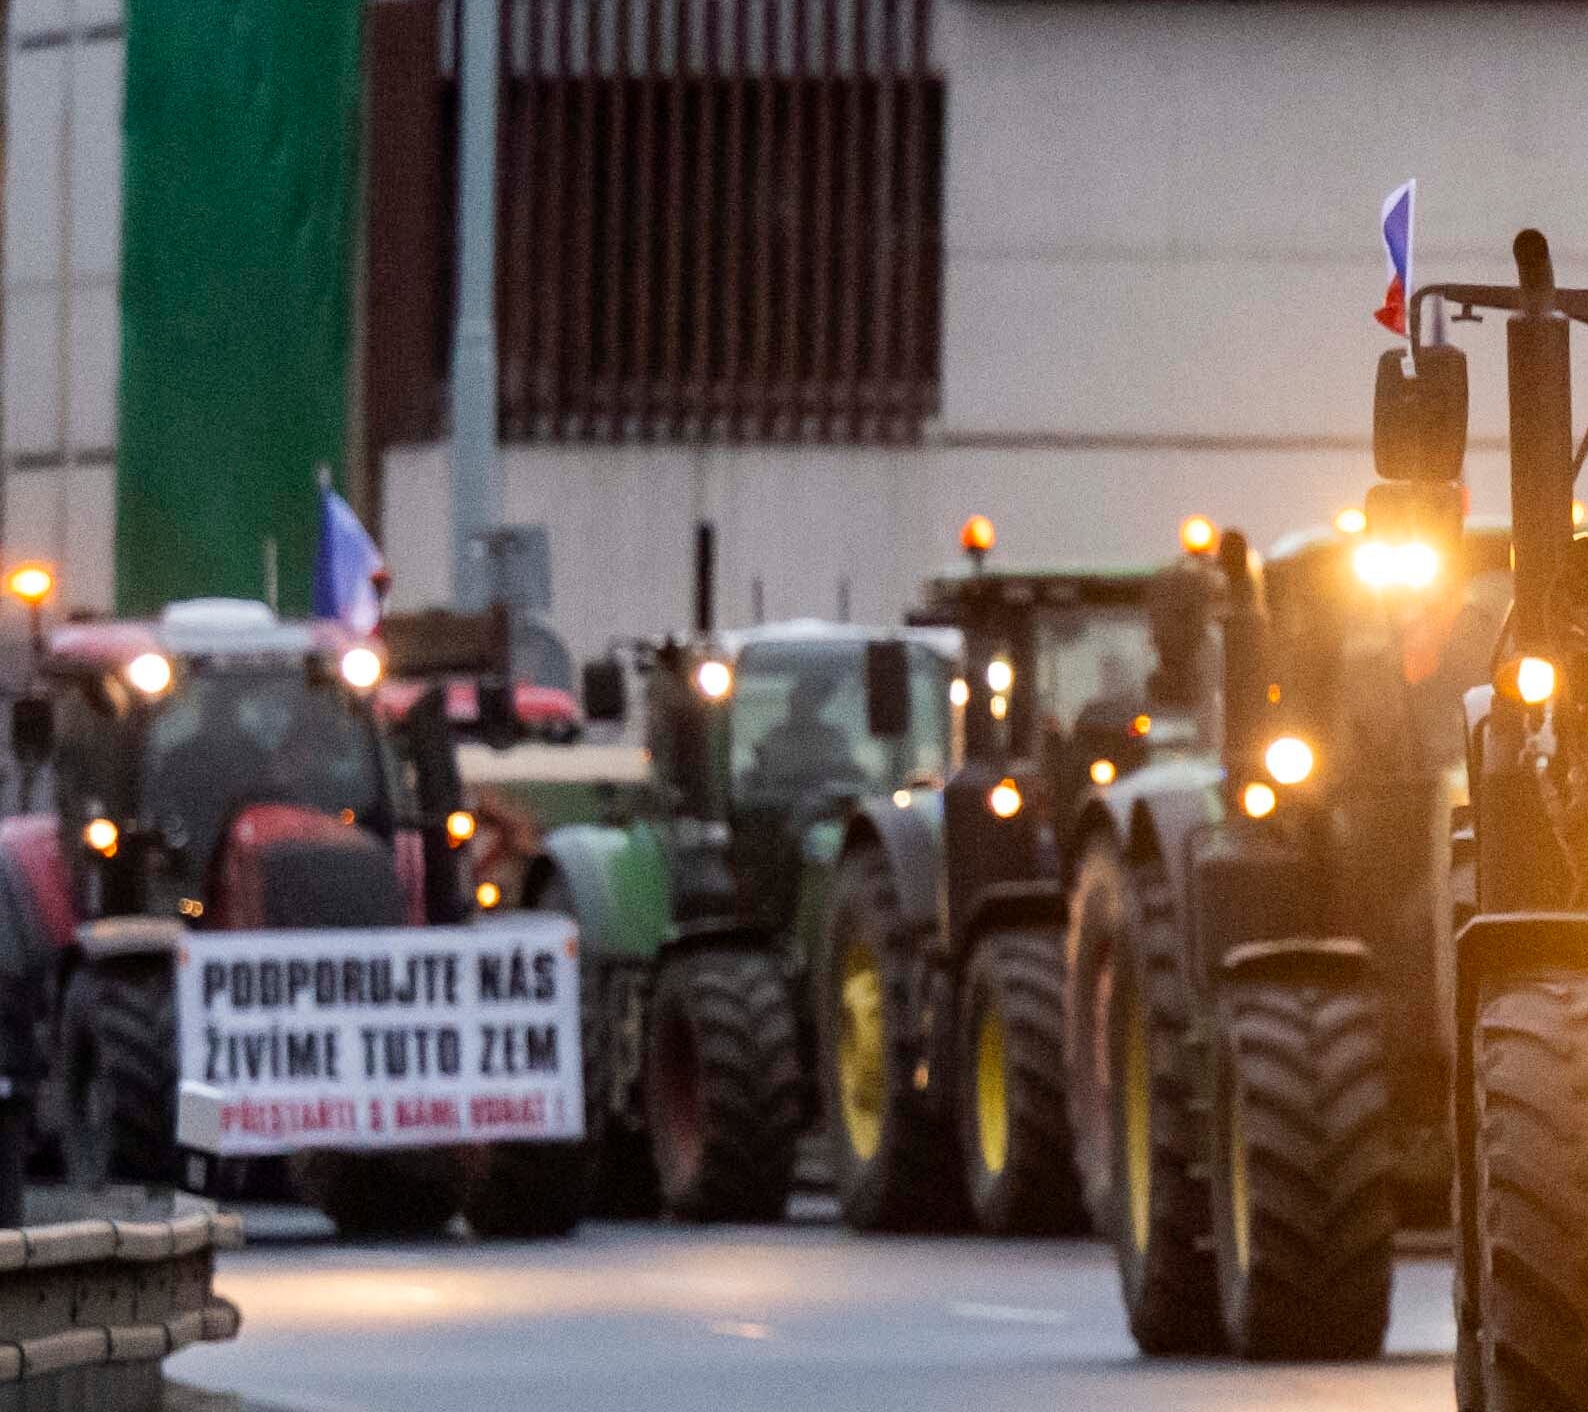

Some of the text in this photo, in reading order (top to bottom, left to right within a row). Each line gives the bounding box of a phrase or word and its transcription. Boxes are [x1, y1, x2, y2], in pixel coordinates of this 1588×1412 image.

[203, 944, 557, 1009] PODPORUJTE NÁS
[204, 1021, 559, 1081] ŽIVÍME TUTO ZEM
